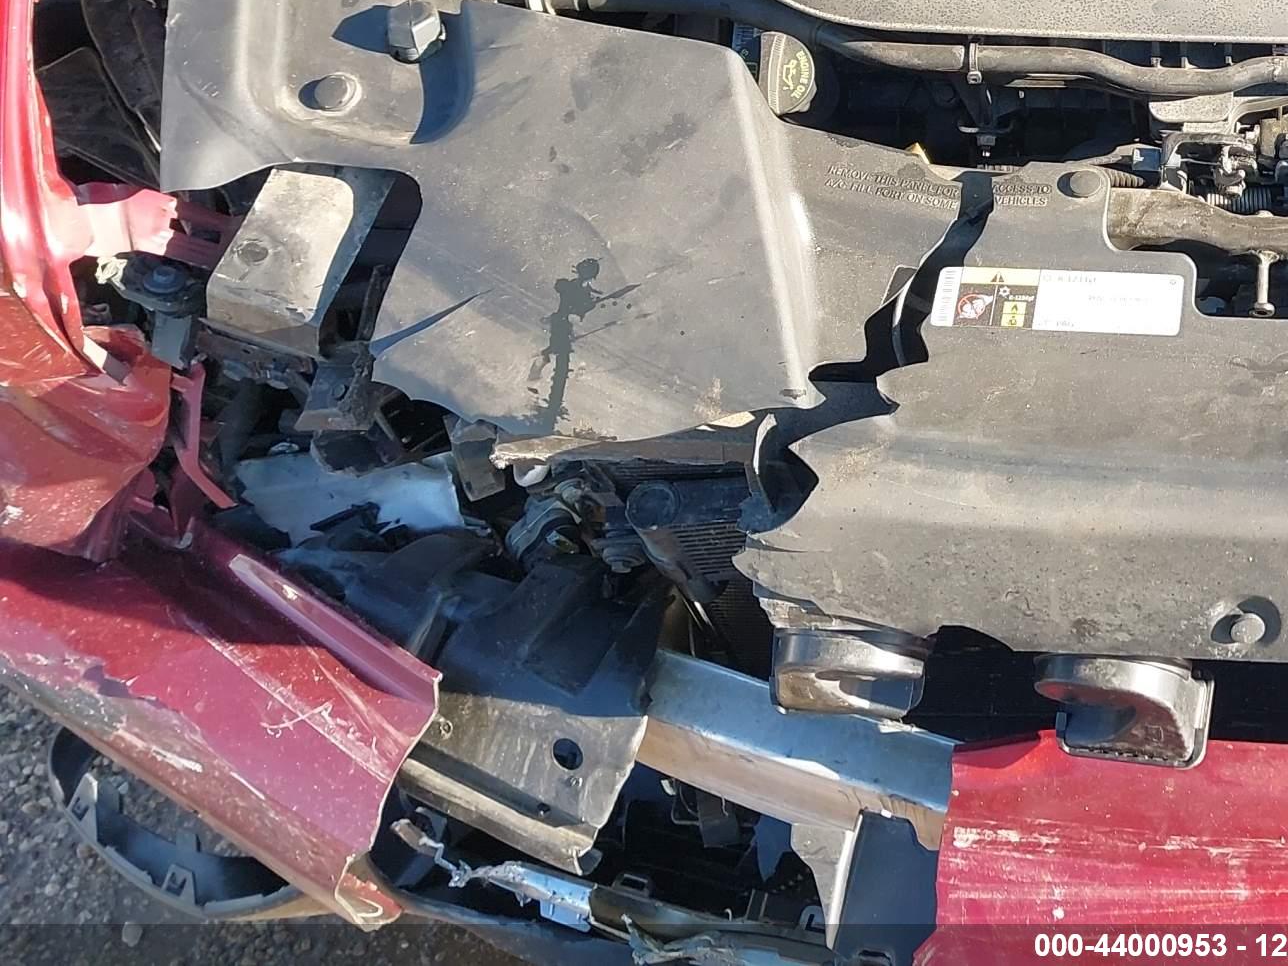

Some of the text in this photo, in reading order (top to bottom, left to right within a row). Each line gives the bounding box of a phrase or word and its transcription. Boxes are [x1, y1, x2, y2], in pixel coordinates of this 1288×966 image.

[790, 49, 811, 99] ENGINE OIL
[824, 177, 848, 189] A/C
[849, 183, 873, 194] FILL
[906, 192, 925, 203] ON
[924, 195, 958, 209] SOME
[994, 195, 1048, 207] VEHICLES
[827, 164, 1051, 197] REMOVE THIS PANEL FOR ACCESS TO
